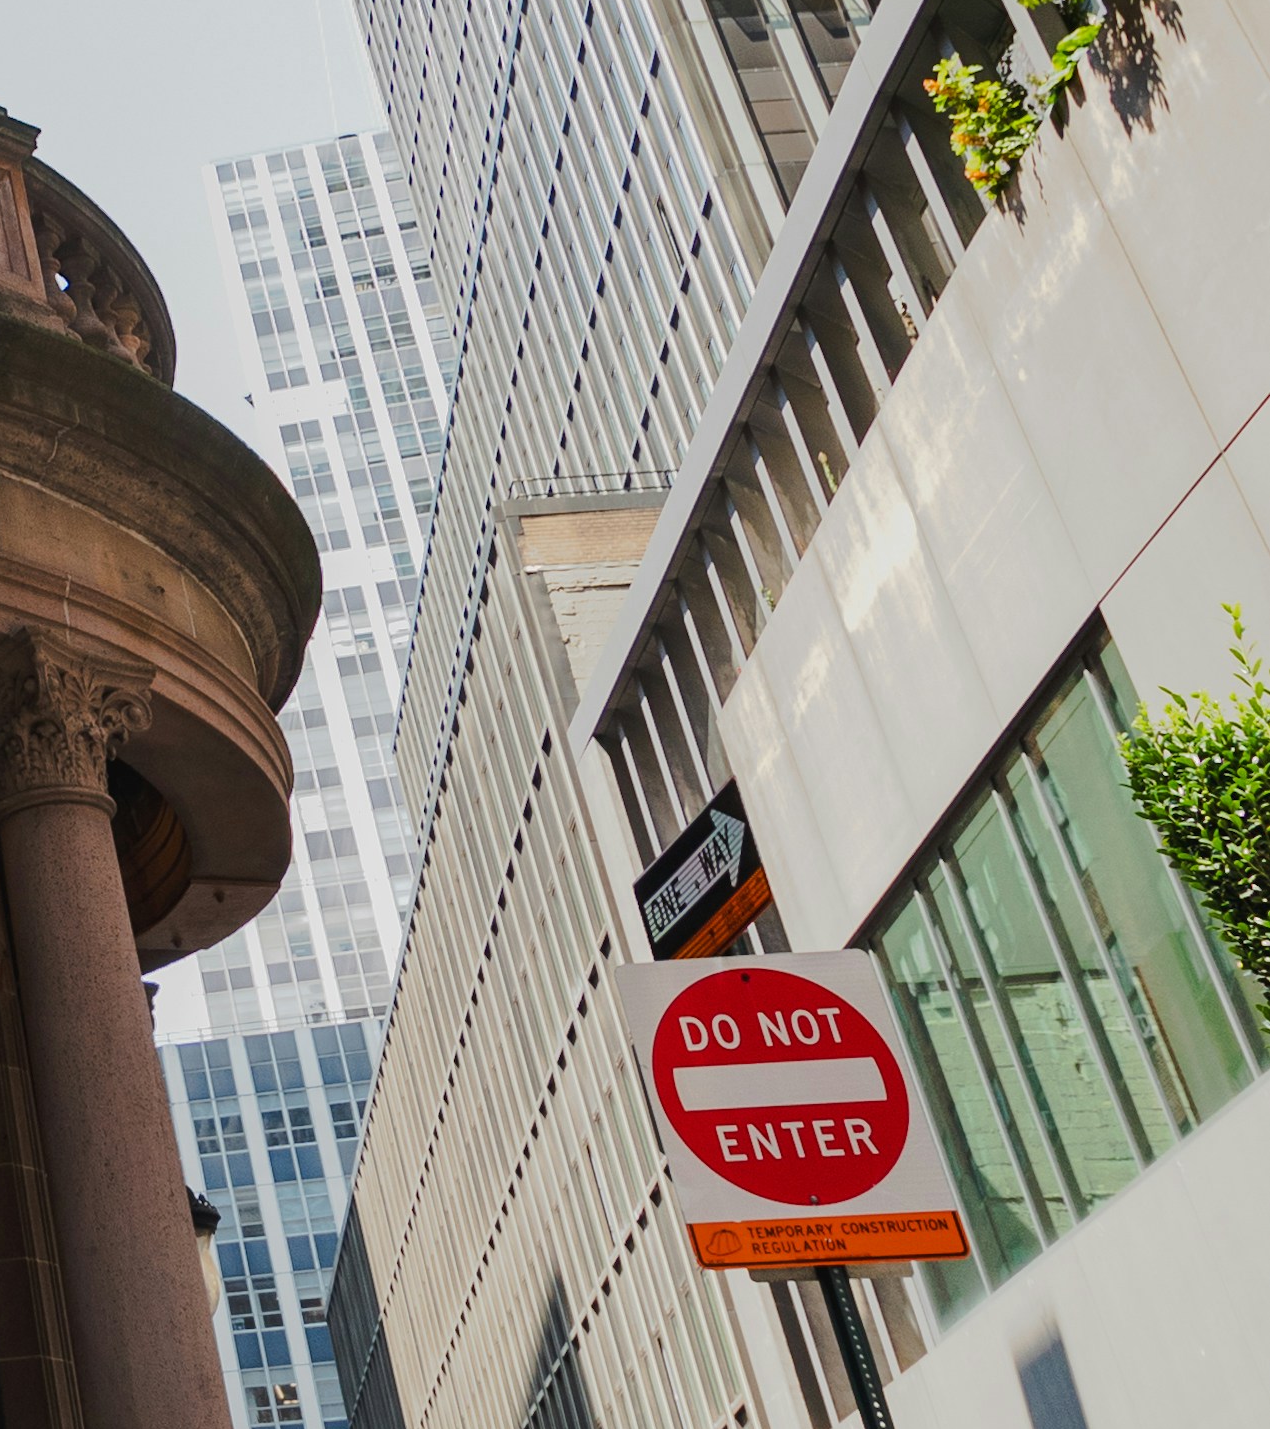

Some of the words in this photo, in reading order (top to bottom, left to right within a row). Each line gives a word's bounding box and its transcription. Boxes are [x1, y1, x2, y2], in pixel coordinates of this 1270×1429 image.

[651, 877, 688, 931] ONE
[698, 823, 733, 884] WAY
[678, 1013, 741, 1052] DO
[757, 1007, 842, 1047] NOT
[715, 1117, 880, 1163] ENTER
[747, 1222, 834, 1240] TEMPORARY
[841, 1218, 950, 1235] CONSTRUCTION
[752, 1239, 848, 1255] REGULATION
